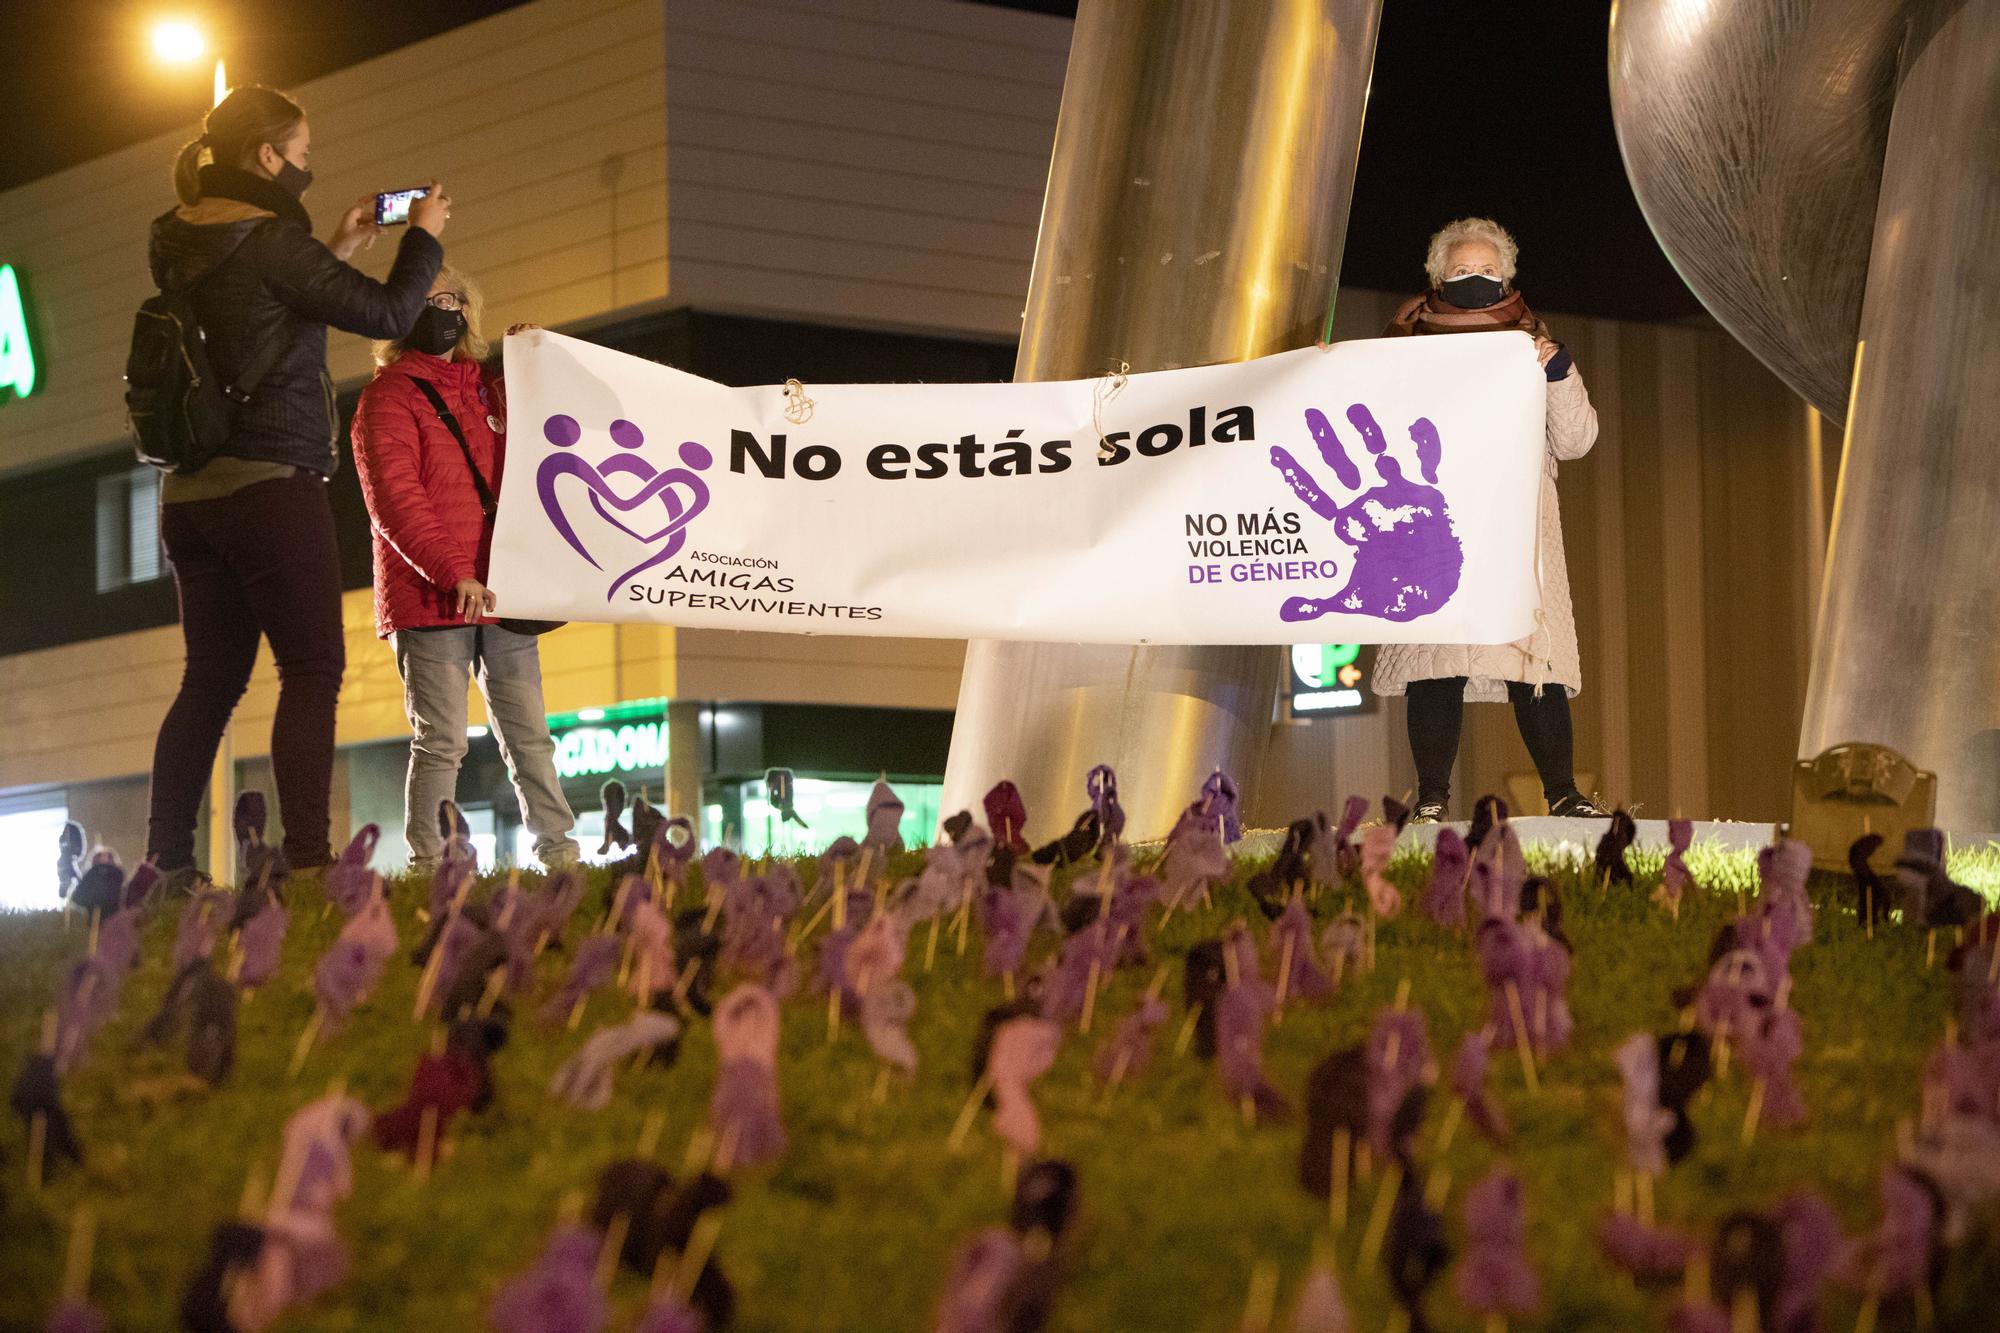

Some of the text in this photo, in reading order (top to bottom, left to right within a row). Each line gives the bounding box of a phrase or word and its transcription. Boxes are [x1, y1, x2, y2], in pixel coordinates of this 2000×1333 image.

[729, 405, 1255, 481] No estás sola
[1185, 507, 1301, 537] NO MÁS
[690, 550, 779, 570] ASOCIACIÓN
[1187, 538, 1309, 558] VIOLENCIA
[664, 565, 795, 594] AMIGAS
[1188, 558, 1338, 584] DE GÉNERO
[629, 584, 882, 621] SUPERVIVIENTES
